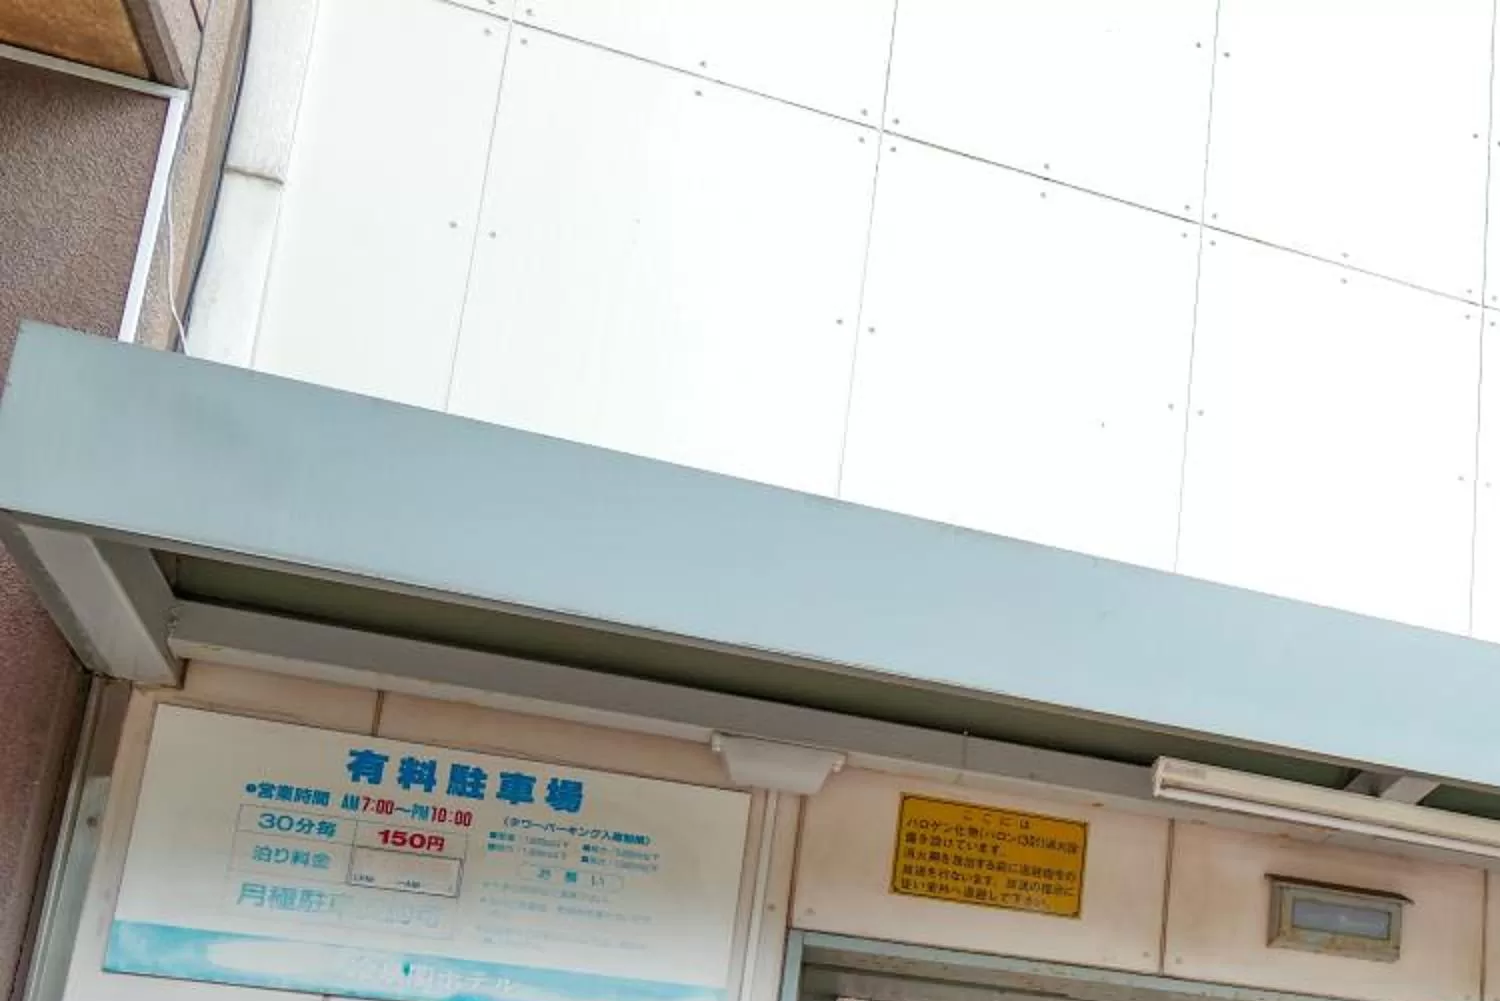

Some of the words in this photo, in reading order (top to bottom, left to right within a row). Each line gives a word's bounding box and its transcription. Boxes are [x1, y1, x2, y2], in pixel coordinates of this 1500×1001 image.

[257, 781, 330, 807] 営業時間
[346, 749, 583, 812] 有料駐車場
[257, 812, 337, 837] 30分毎
[378, 828, 445, 852] 150円
[252, 844, 331, 869] 泊り料金
